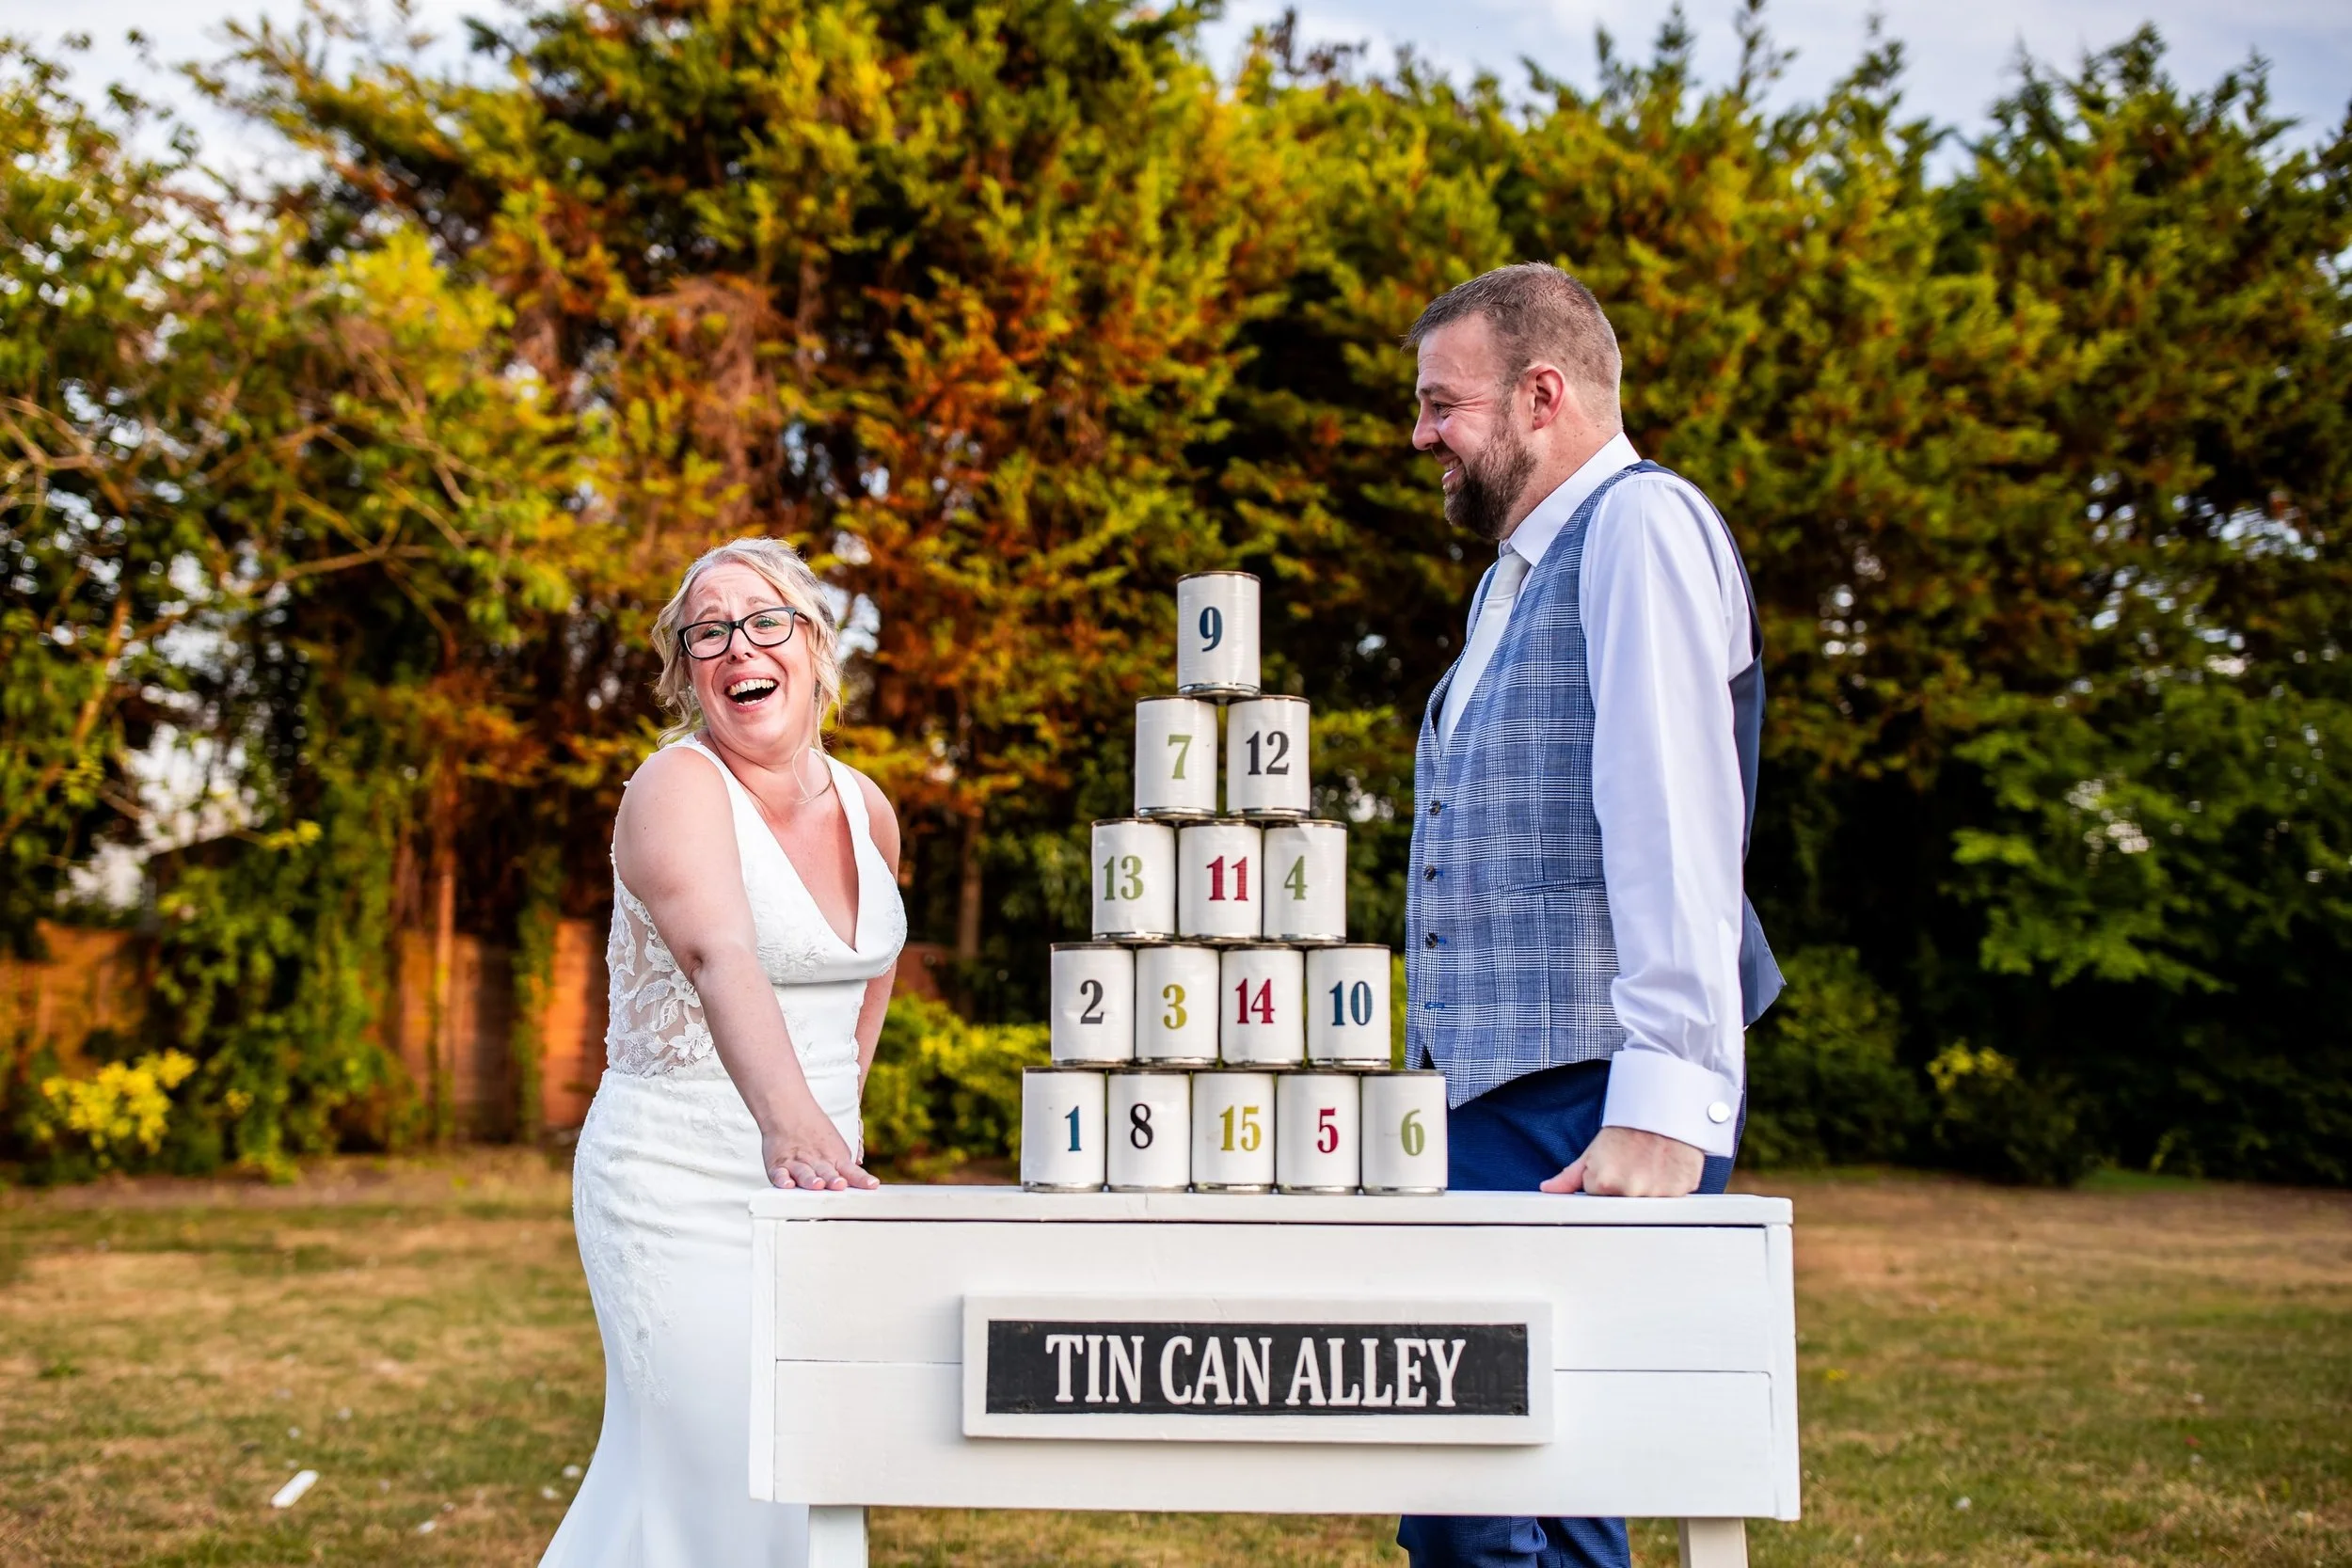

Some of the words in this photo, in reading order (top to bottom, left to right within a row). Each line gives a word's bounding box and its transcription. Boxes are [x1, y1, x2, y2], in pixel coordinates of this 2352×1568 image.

[1199, 607, 1222, 652] 9
[1168, 734, 1192, 779] 7
[1246, 731, 1289, 776] 12
[1103, 855, 1143, 901] 13
[1206, 856, 1248, 901] 11
[1284, 856, 1308, 900] 4
[1080, 979, 1104, 1024] 2
[1162, 984, 1187, 1030] 3
[1235, 978, 1275, 1024] 14
[1328, 980, 1372, 1027] 10
[1065, 1106, 1082, 1151] 1
[1130, 1103, 1153, 1149] 8
[1219, 1105, 1261, 1151] 15
[1317, 1108, 1339, 1153] 5
[1401, 1110, 1424, 1156] 6
[1046, 1335, 1144, 1402] TIN
[1161, 1336, 1272, 1404] CAN
[1286, 1338, 1466, 1406] ALLEY
